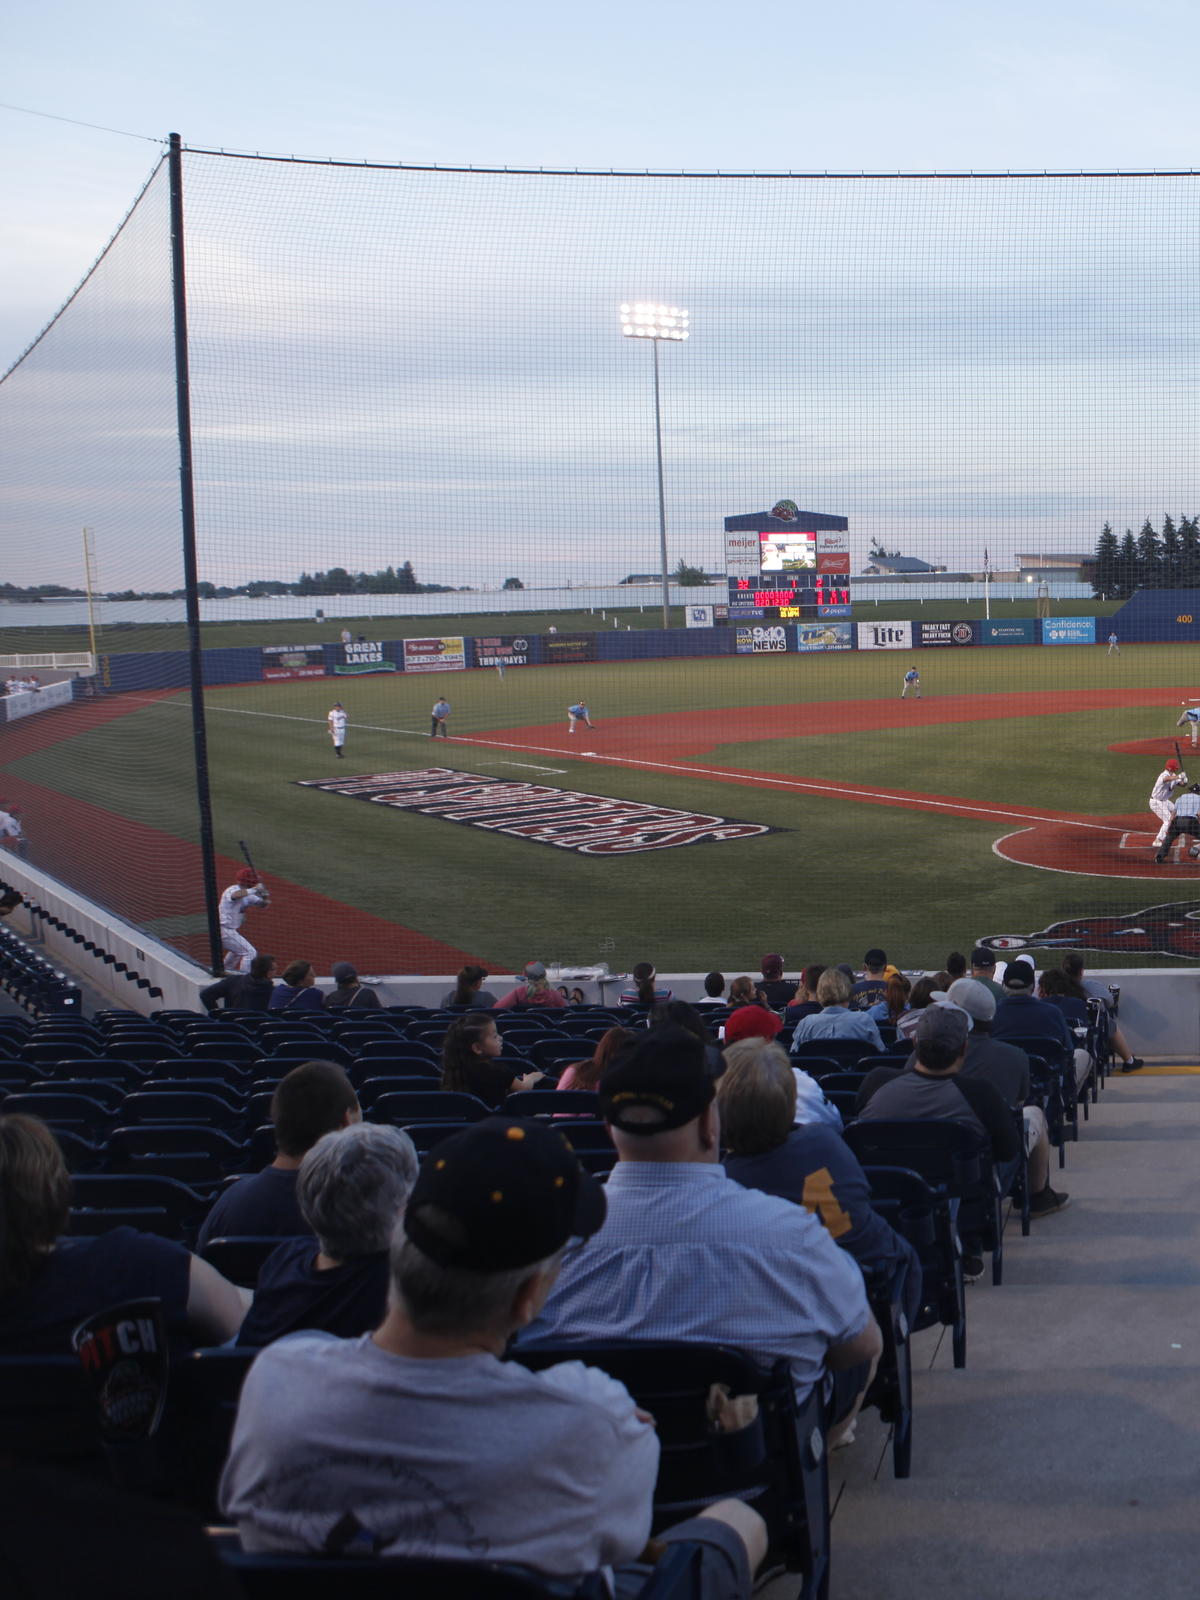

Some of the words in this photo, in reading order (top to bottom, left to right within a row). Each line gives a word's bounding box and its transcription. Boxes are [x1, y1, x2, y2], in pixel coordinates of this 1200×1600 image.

[729, 537, 756, 548] meijer
[1176, 615, 1193, 624] 400
[753, 626, 785, 641] 9&10
[873, 627, 904, 647] Lite
[345, 641, 383, 654] GREAT
[754, 640, 785, 650] NEWS
[346, 652, 383, 664] LAKES
[370, 782, 769, 854] SPITTERS
